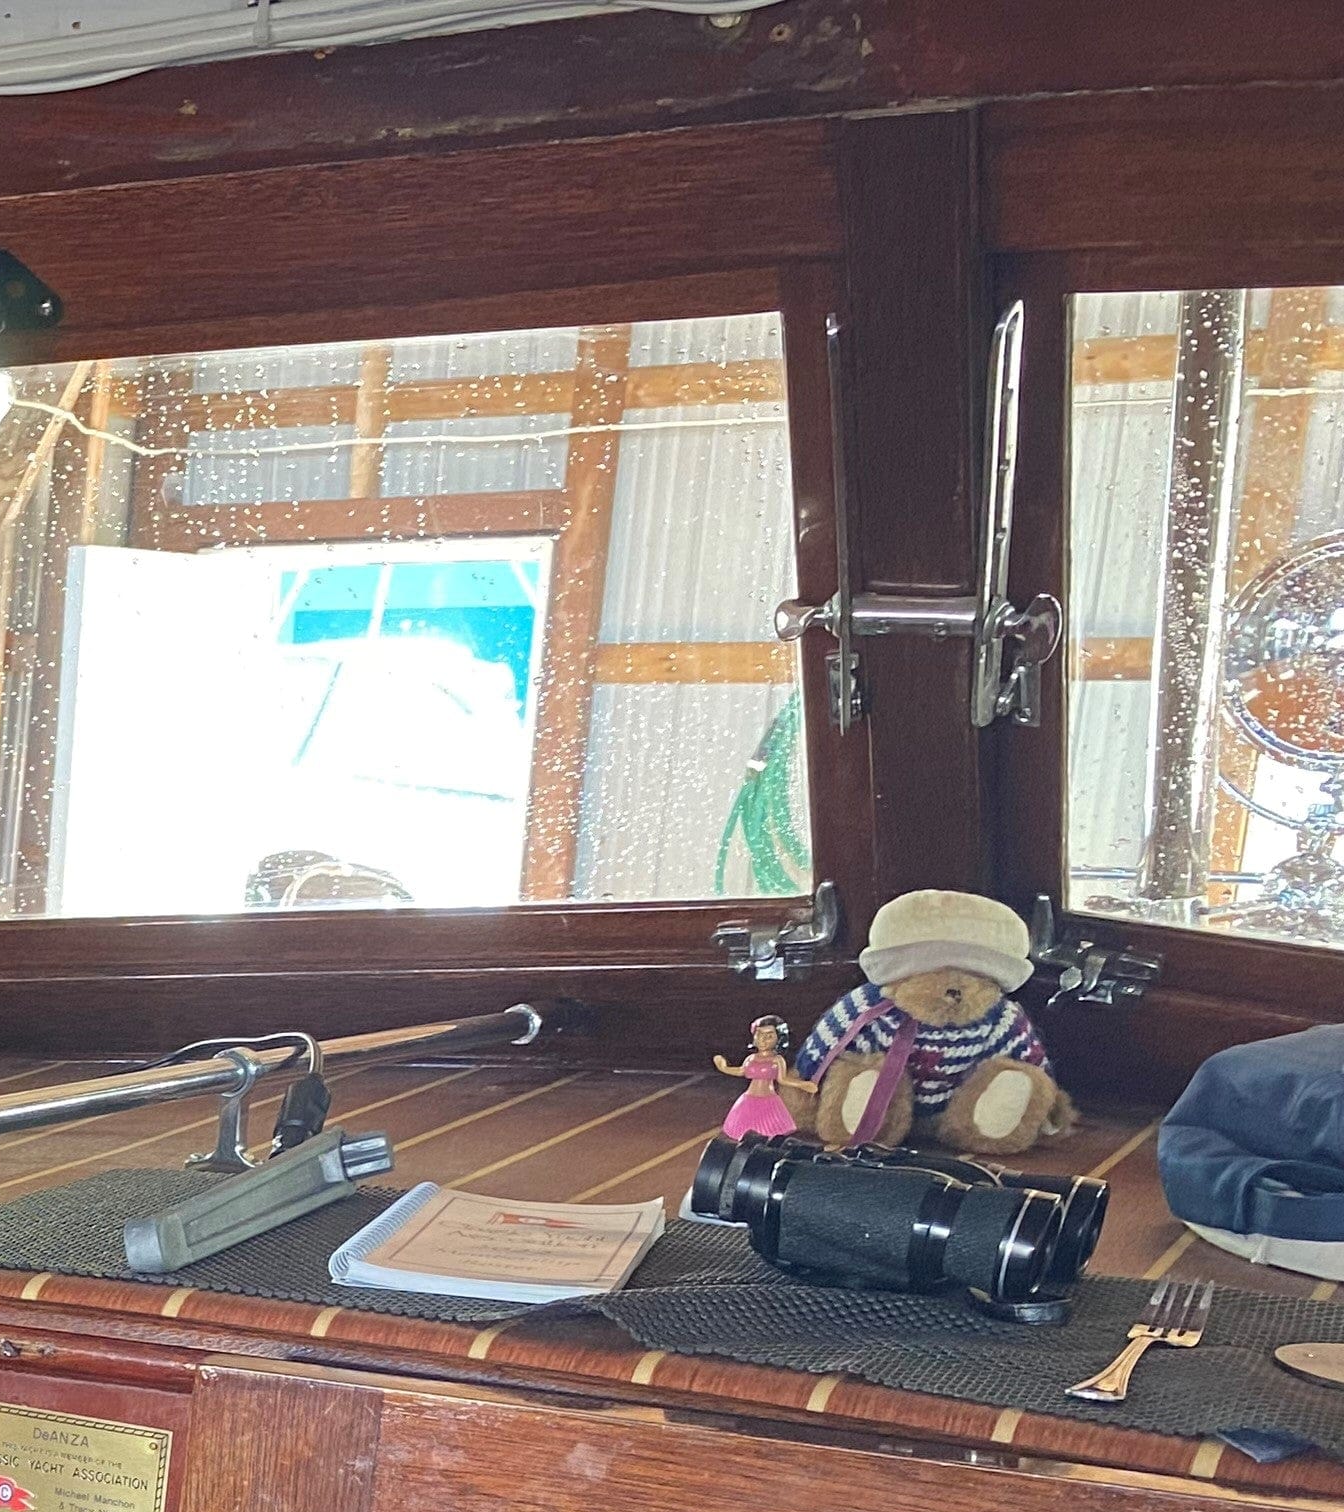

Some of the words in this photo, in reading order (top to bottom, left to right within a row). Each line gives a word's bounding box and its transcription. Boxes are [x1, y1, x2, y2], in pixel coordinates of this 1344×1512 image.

[33, 1427, 89, 1448] DeANZA
[29, 1458, 64, 1474] YACHT
[72, 1467, 149, 1491] ASSOCIATION
